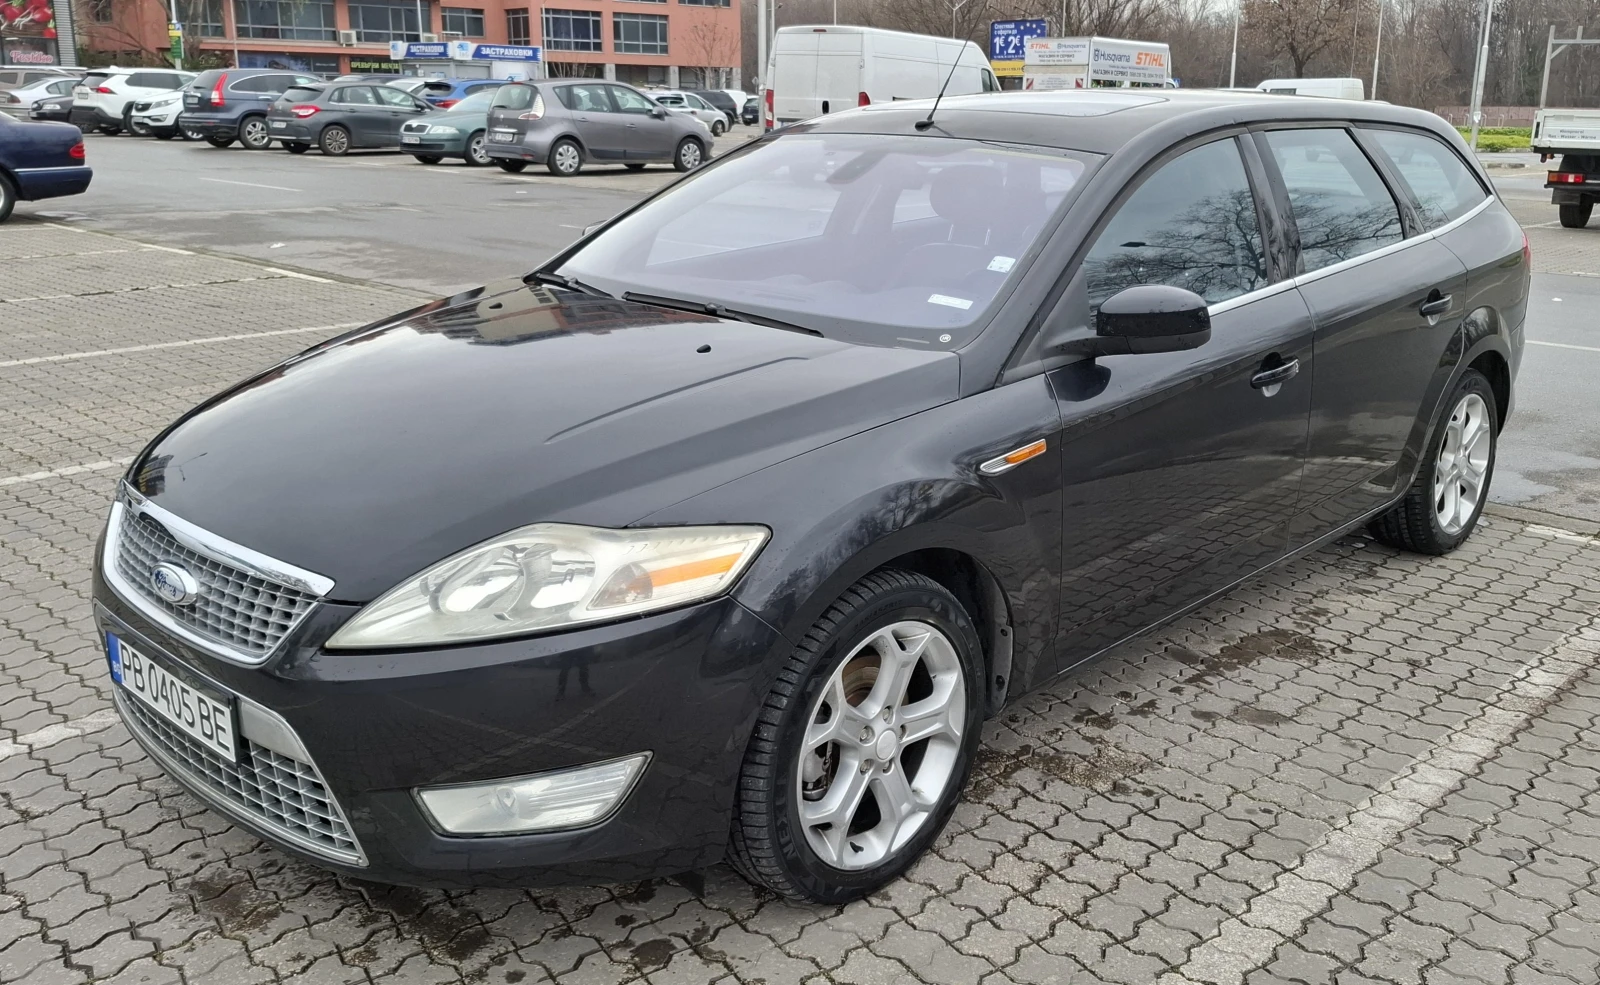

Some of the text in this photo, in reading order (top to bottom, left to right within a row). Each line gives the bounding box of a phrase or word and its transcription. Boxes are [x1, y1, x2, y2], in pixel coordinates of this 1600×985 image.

[409, 45, 445, 53] ЗАСТРАХОВКИ
[480, 47, 534, 56] ЗАСТРАХОВКИ
[1100, 50, 1165, 67] Husqvarna STIHL
[113, 661, 121, 674] BG
[120, 643, 231, 753] PB 0405 BE
